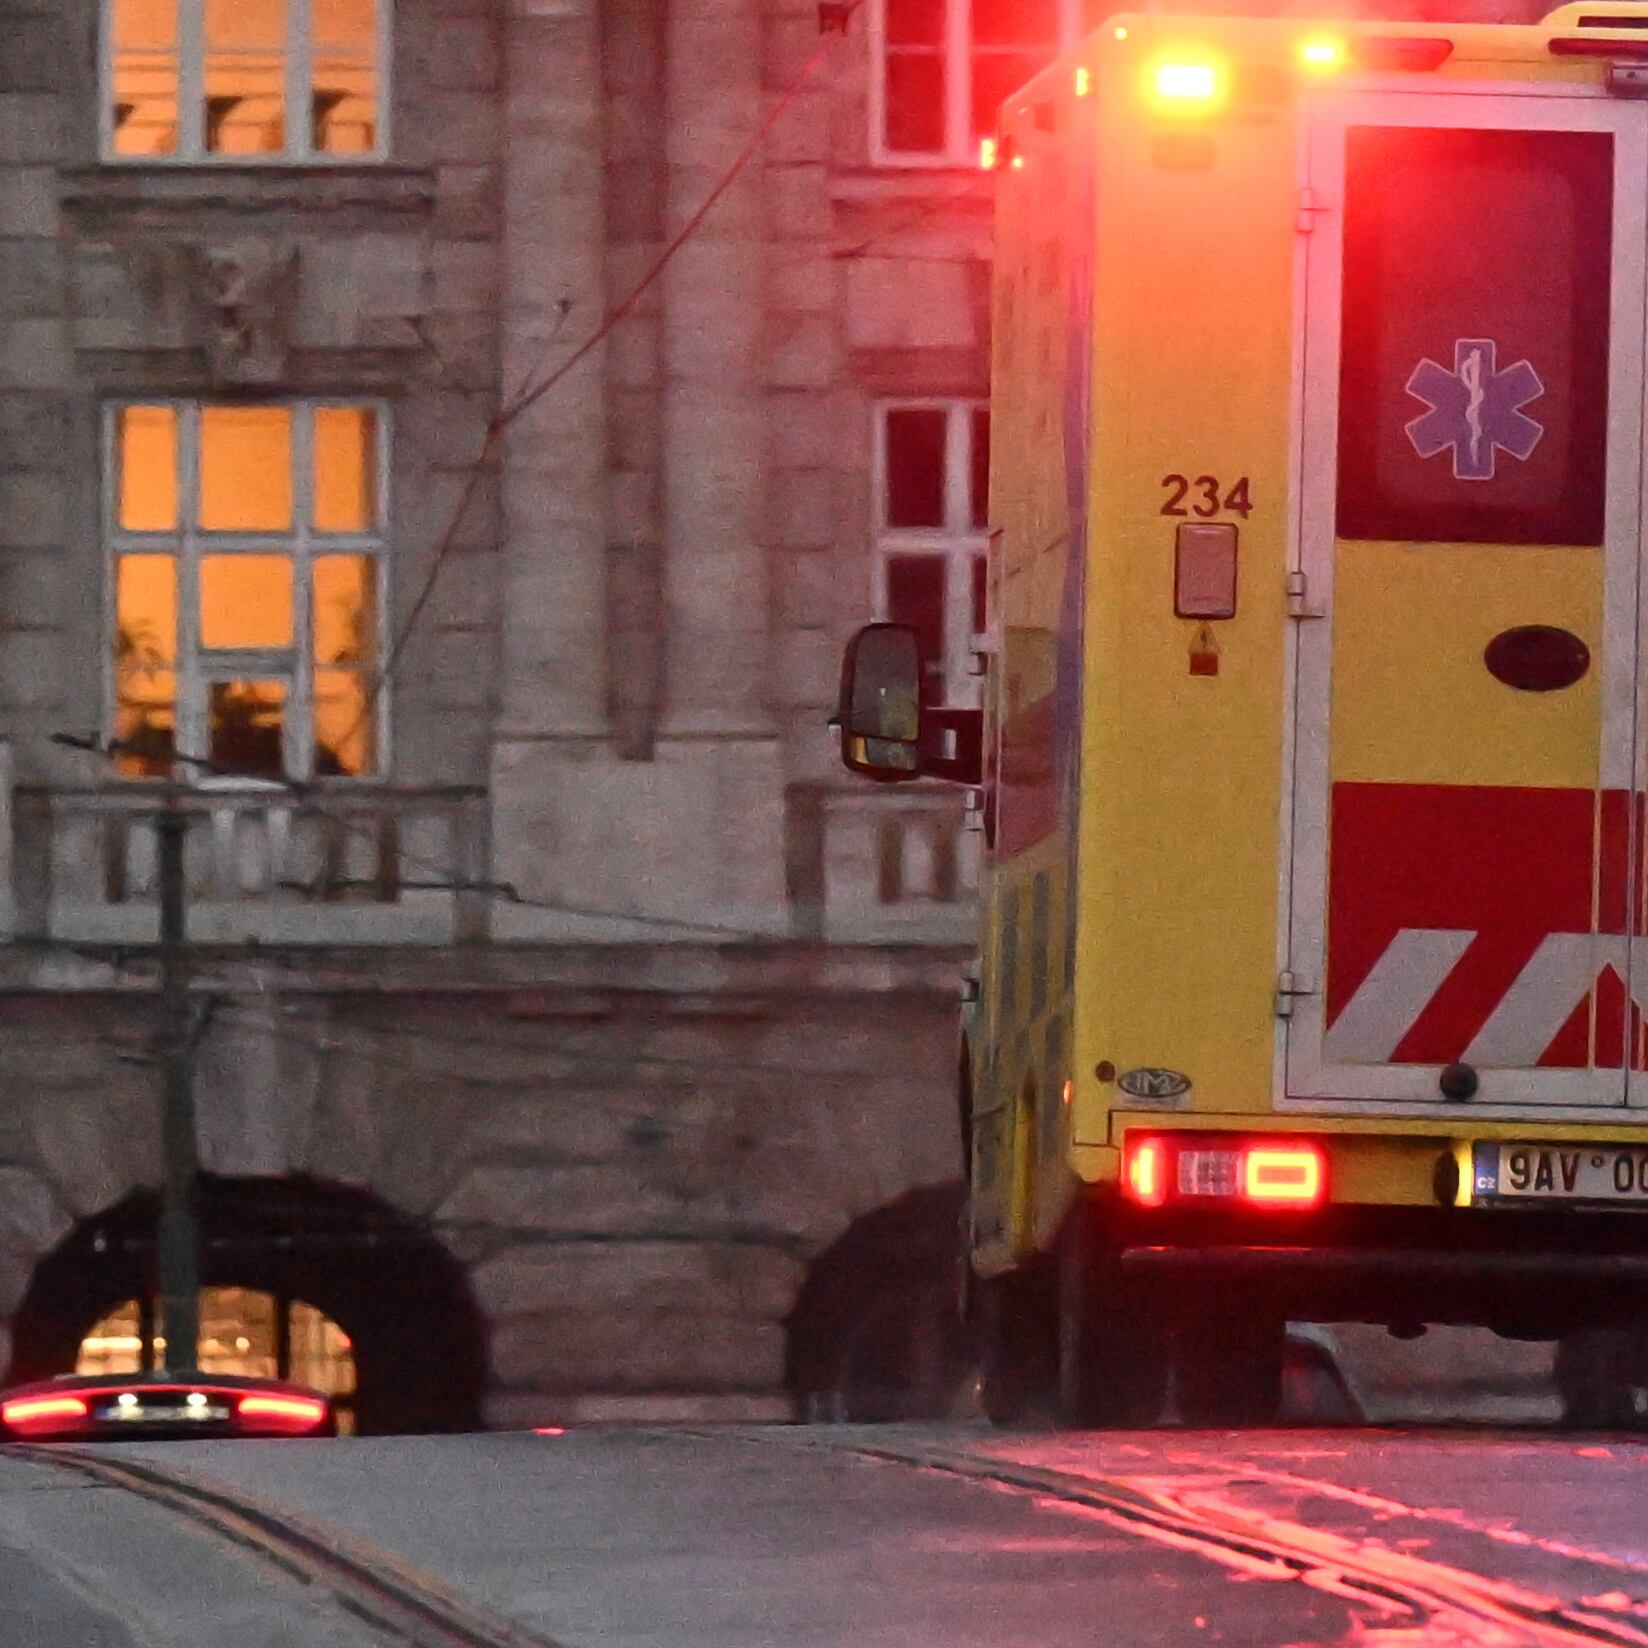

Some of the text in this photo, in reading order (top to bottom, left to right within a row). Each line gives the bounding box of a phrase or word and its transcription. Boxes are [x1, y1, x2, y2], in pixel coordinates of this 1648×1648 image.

[1159, 474, 1253, 519] 234
[1477, 1176, 1496, 1189] CZ
[1509, 1148, 1580, 1192] 9AV
